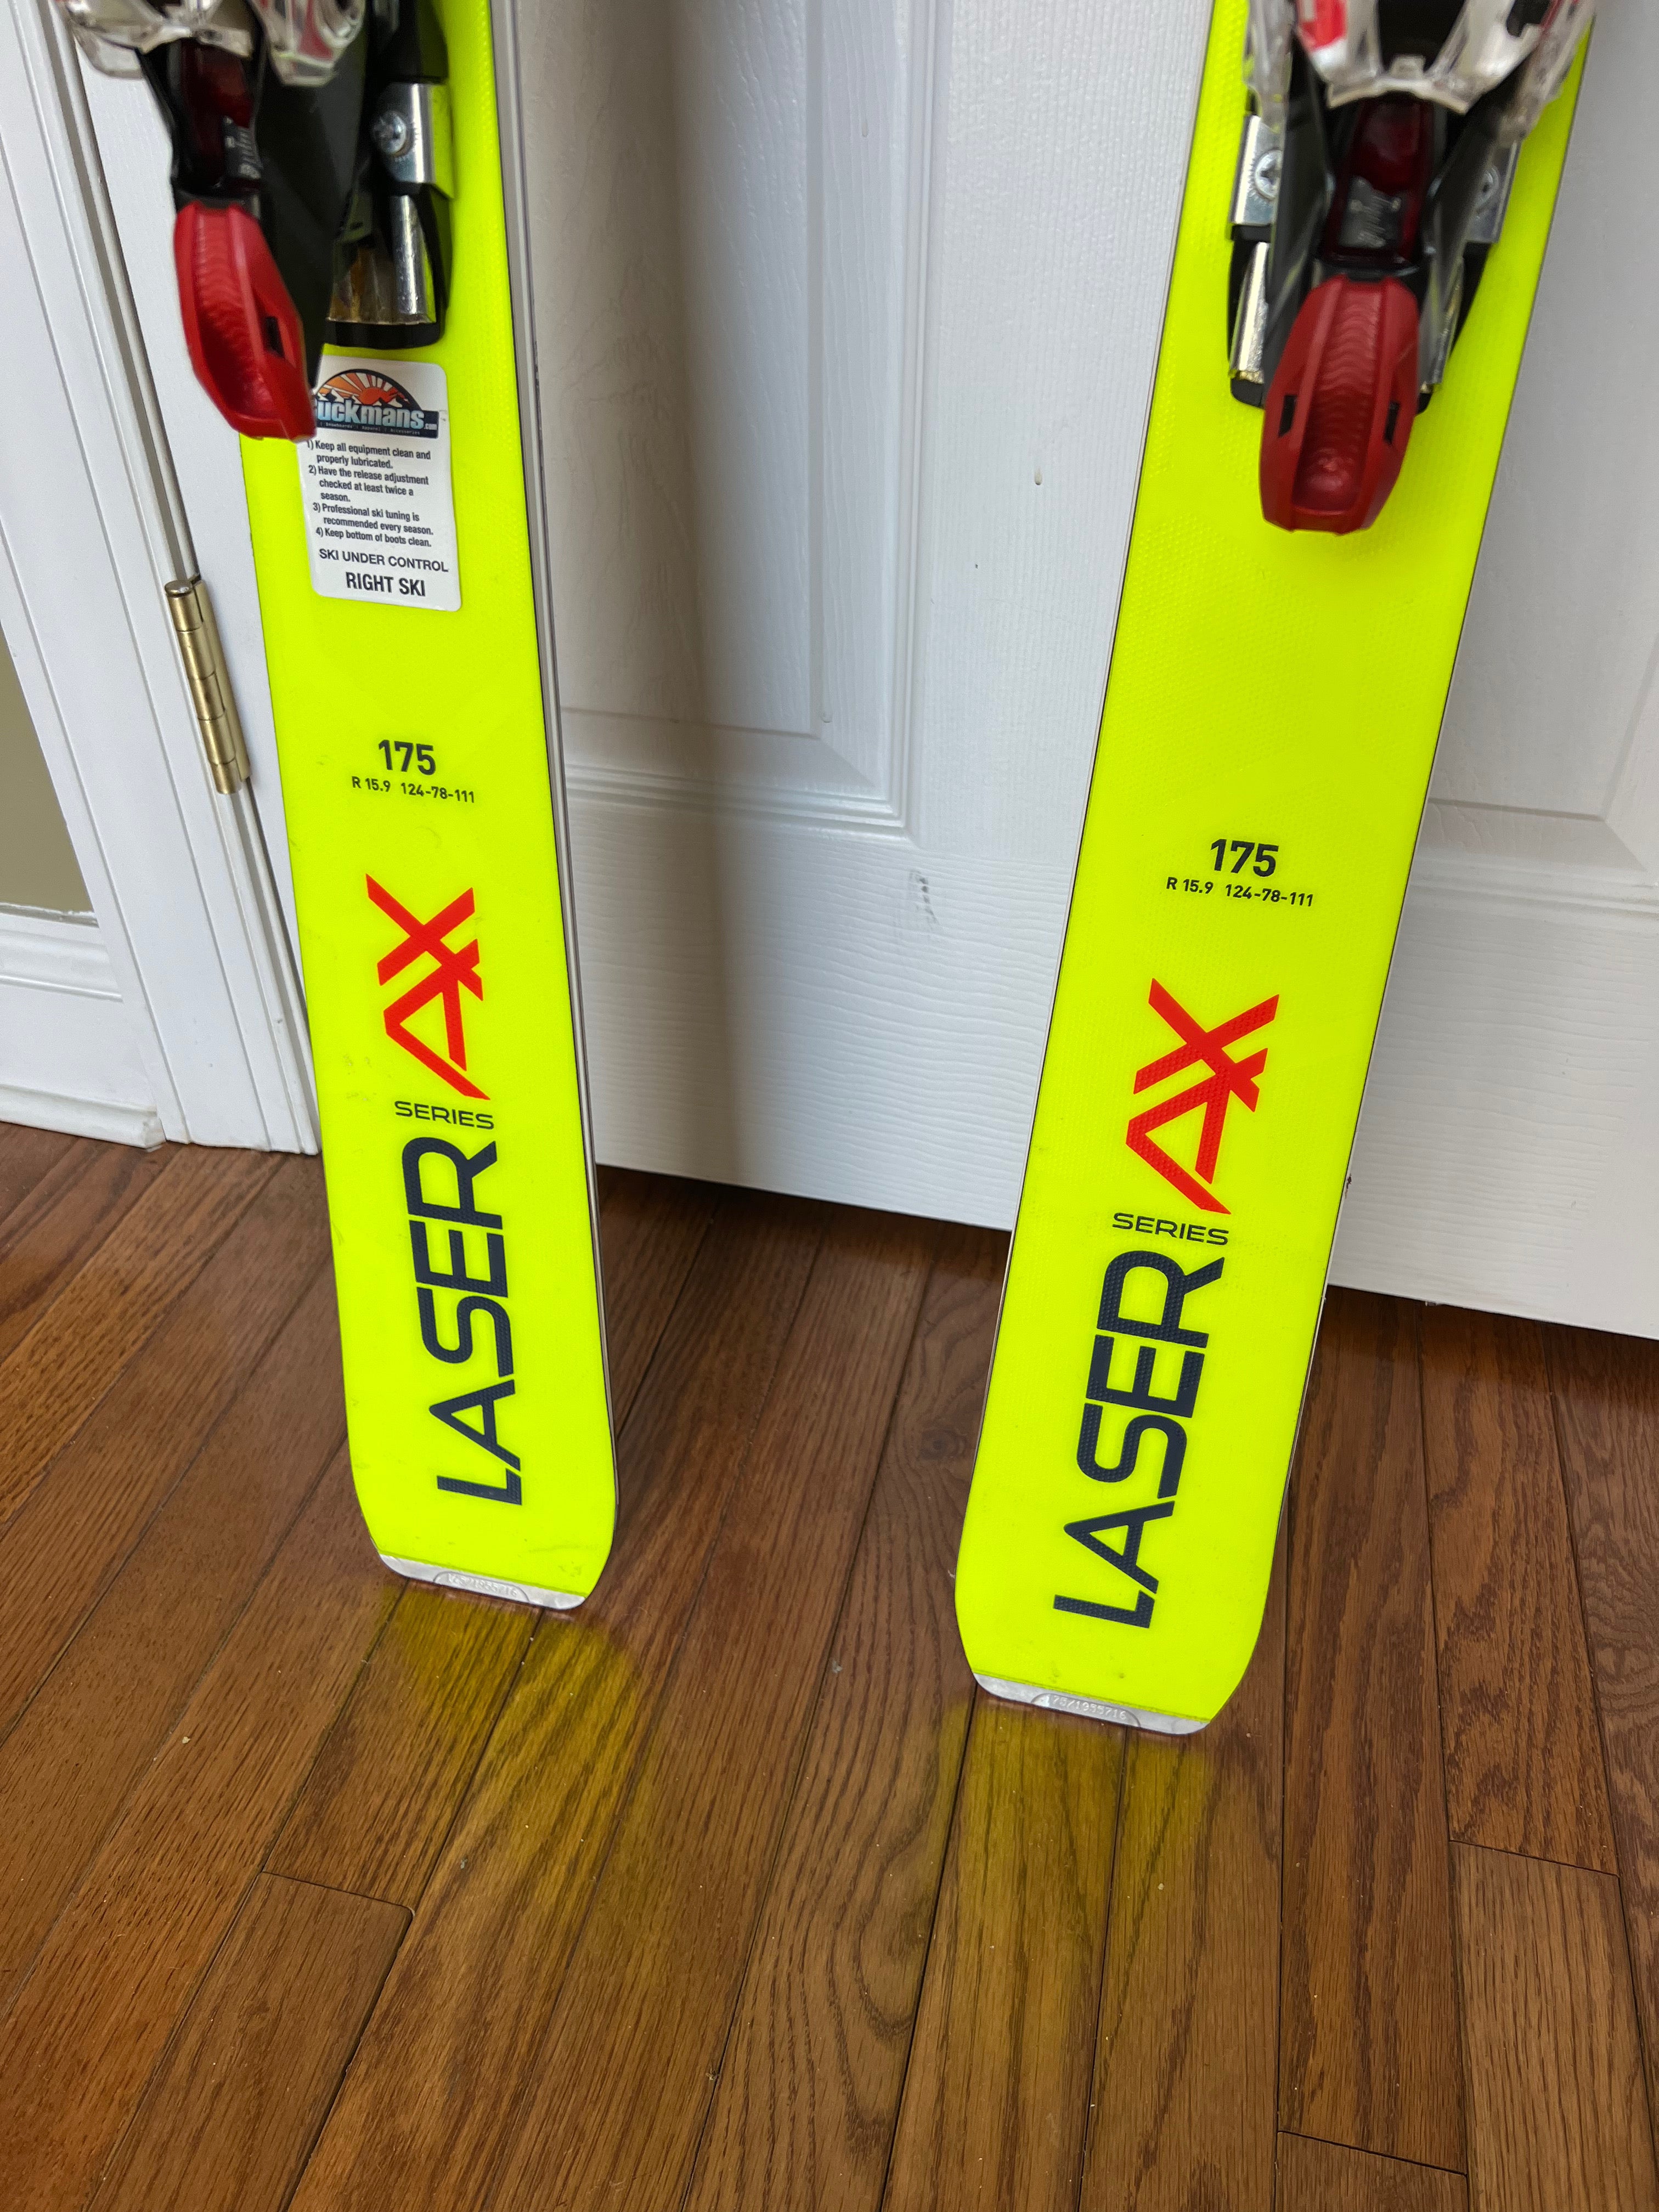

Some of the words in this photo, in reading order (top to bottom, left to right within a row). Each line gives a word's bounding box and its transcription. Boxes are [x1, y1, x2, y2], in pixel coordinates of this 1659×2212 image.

[315, 440, 335, 452] Keep
[337, 442, 346, 452] all
[349, 444, 391, 456] equipment
[392, 448, 414, 458] clean
[416, 451, 431, 460] and
[317, 454, 349, 466] properly
[351, 456, 393, 469] lubricated.
[308, 465, 317, 476] 2)
[318, 466, 337, 476] Have
[339, 467, 352, 477] the
[354, 470, 382, 481] release
[385, 473, 429, 485] adjustment
[319, 478, 352, 490] checked
[354, 482, 362, 491] at
[364, 483, 383, 493] least
[385, 486, 407, 495] twice
[320, 492, 351, 502] season.
[313, 502, 321, 513] 3)
[323, 504, 370, 516] Professional
[371, 508, 383, 517] ski
[386, 510, 410, 522] tuning
[412, 512, 420, 521] is
[315, 527, 324, 538] 4)
[325, 528, 344, 539] Keep
[346, 530, 373, 541] bottom
[375, 533, 382, 541] of
[385, 534, 407, 544] boots
[408, 538, 432, 547] clean.
[324, 517, 378, 529] recommended
[380, 523, 401, 533] every
[403, 526, 434, 535] season.
[319, 548, 339, 561] SKI
[342, 551, 385, 566] UNDER
[388, 556, 449, 572] CONTROL
[346, 572, 394, 593] RIGHT
[399, 578, 426, 597] SKI
[379, 740, 436, 776] 175
[352, 776, 362, 789] R
[365, 777, 391, 792] 15.9
[400, 782, 475, 803] 124-78-111
[1211, 838, 1279, 877] 175
[1166, 876, 1178, 890] R
[1183, 878, 1214, 894] 15.9
[1225, 884, 1313, 907] 124-78-111
[394, 1100, 494, 1130] SERIES
[1112, 1212, 1229, 1246] SERIES
[402, 1137, 522, 1505] LASER
[1053, 1250, 1225, 1629] LASER
